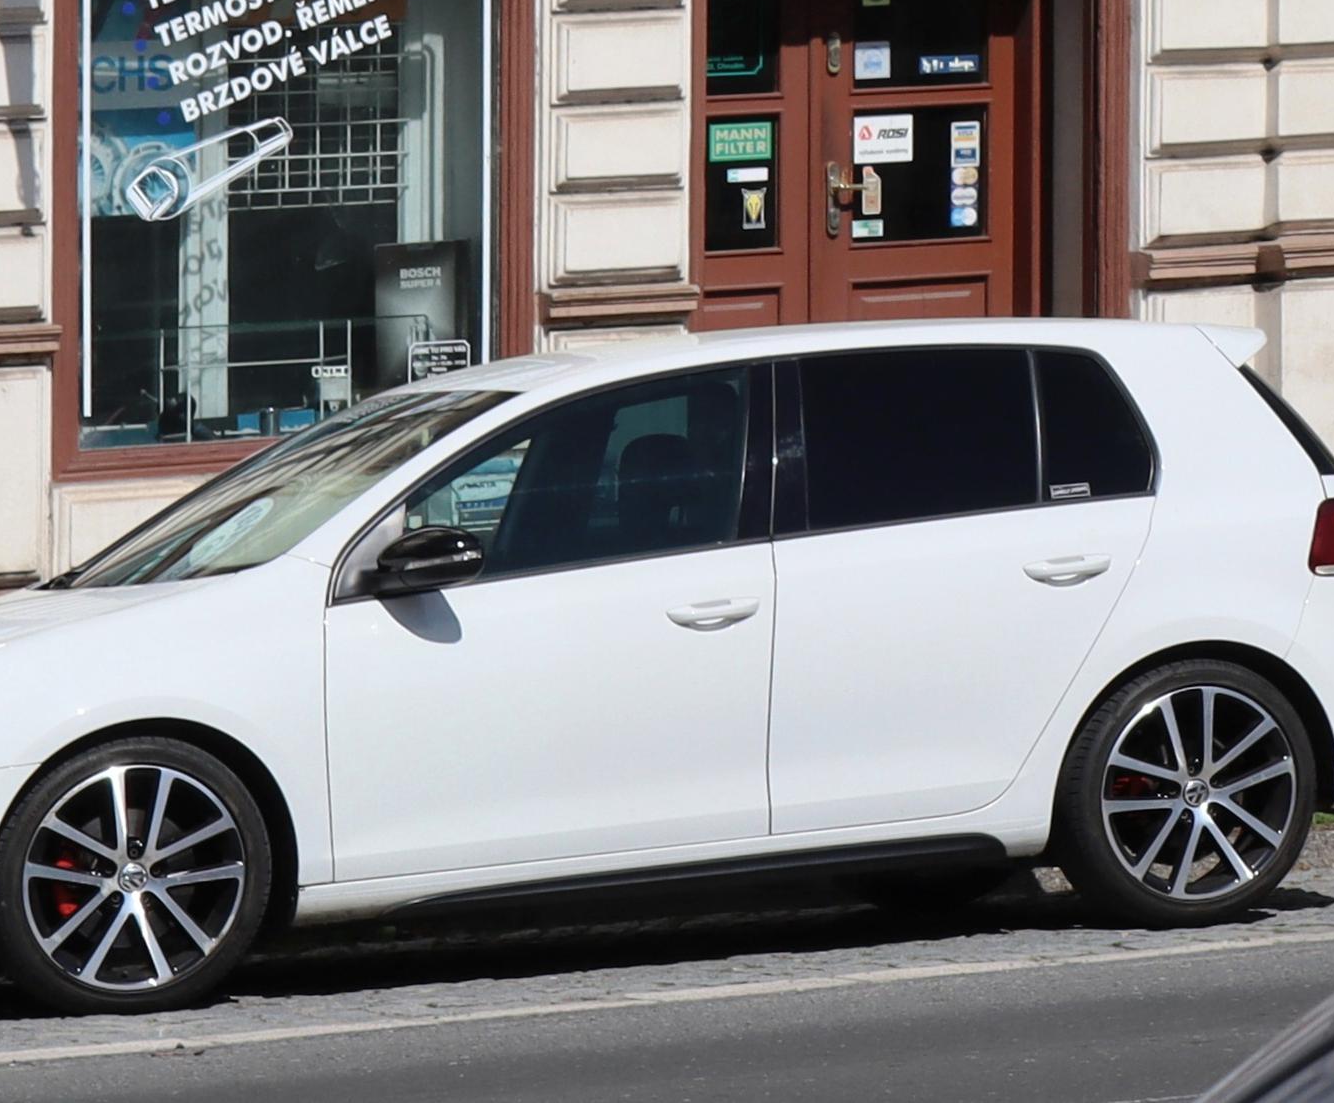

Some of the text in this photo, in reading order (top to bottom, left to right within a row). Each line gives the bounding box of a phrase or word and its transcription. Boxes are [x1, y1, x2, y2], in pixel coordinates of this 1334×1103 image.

[169, 19, 292, 86] ROZVOD.
[179, 14, 393, 124] BRZDOVÉ VÁLCE
[715, 126, 767, 141] MANN
[877, 127, 909, 140] ROSI
[715, 140, 767, 155] FILTER
[399, 266, 442, 280] BOSCH
